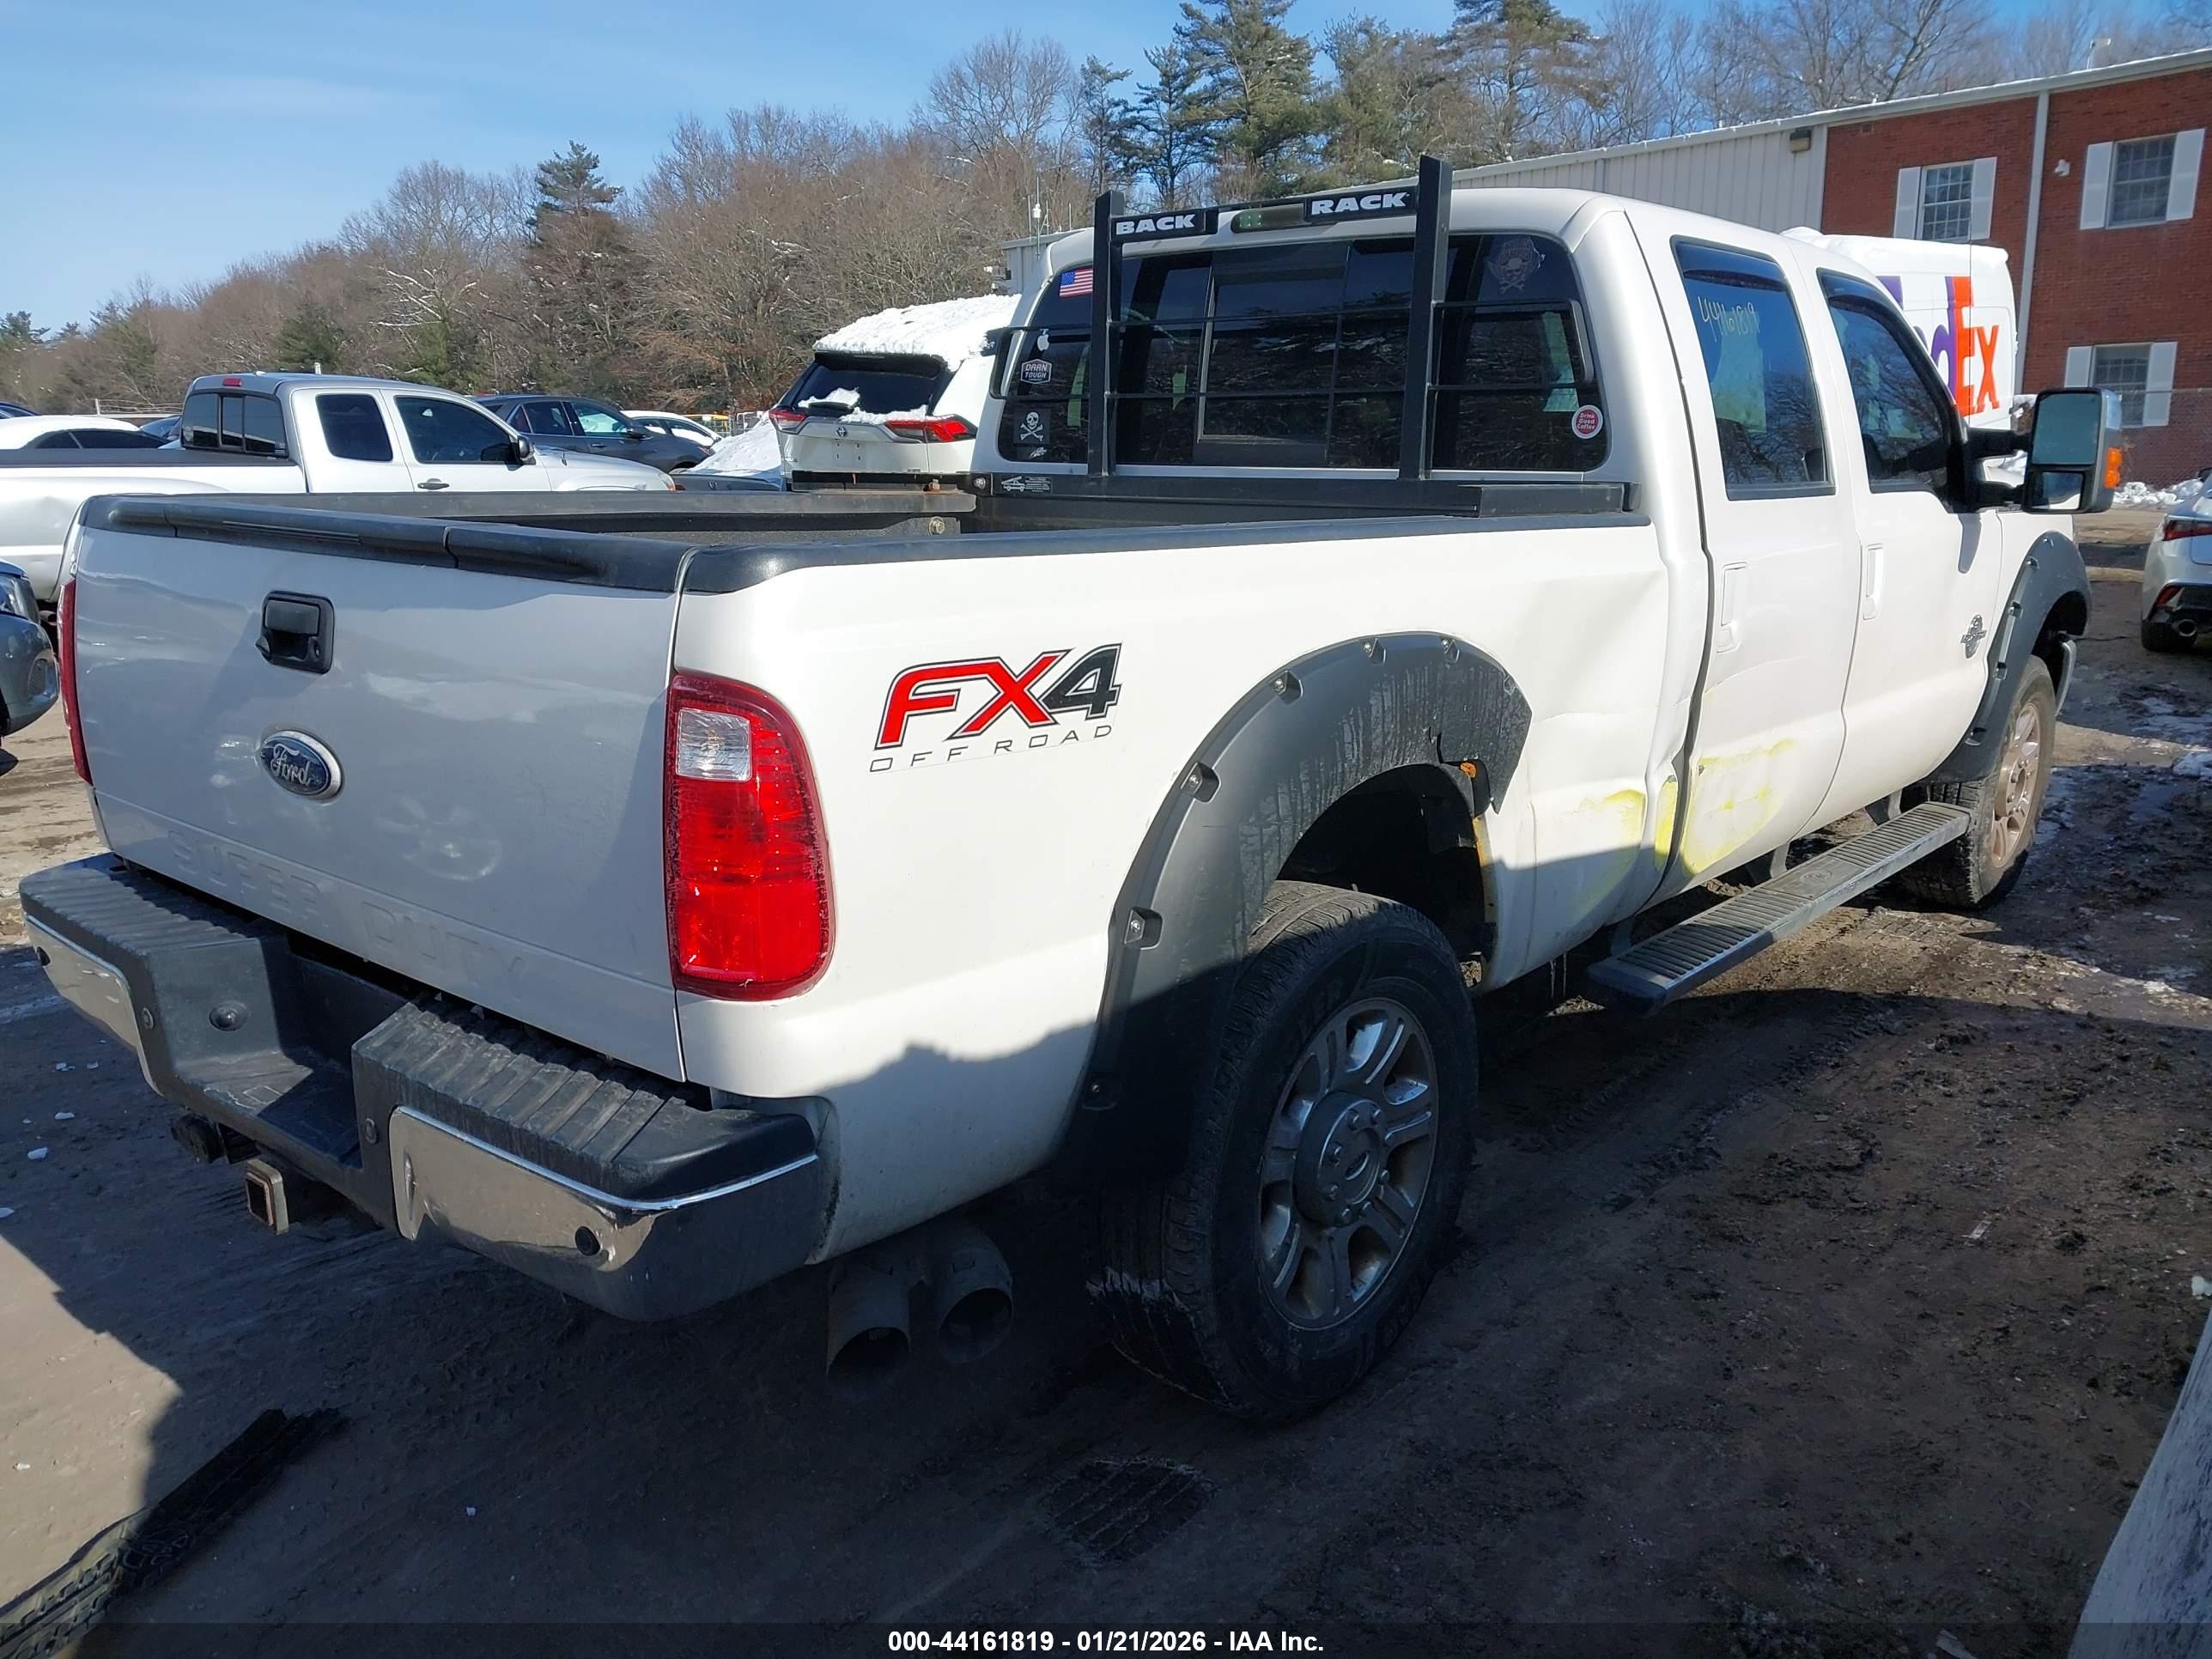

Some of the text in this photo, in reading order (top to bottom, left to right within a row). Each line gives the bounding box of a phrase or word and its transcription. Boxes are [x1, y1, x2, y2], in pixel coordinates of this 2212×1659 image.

[1115, 192, 1408, 235] BACK RACK
[1697, 295, 1761, 343] 44161819
[874, 642, 1123, 750] FX4
[268, 743, 313, 787] Ford
[869, 724, 1112, 773] OFF ROAD
